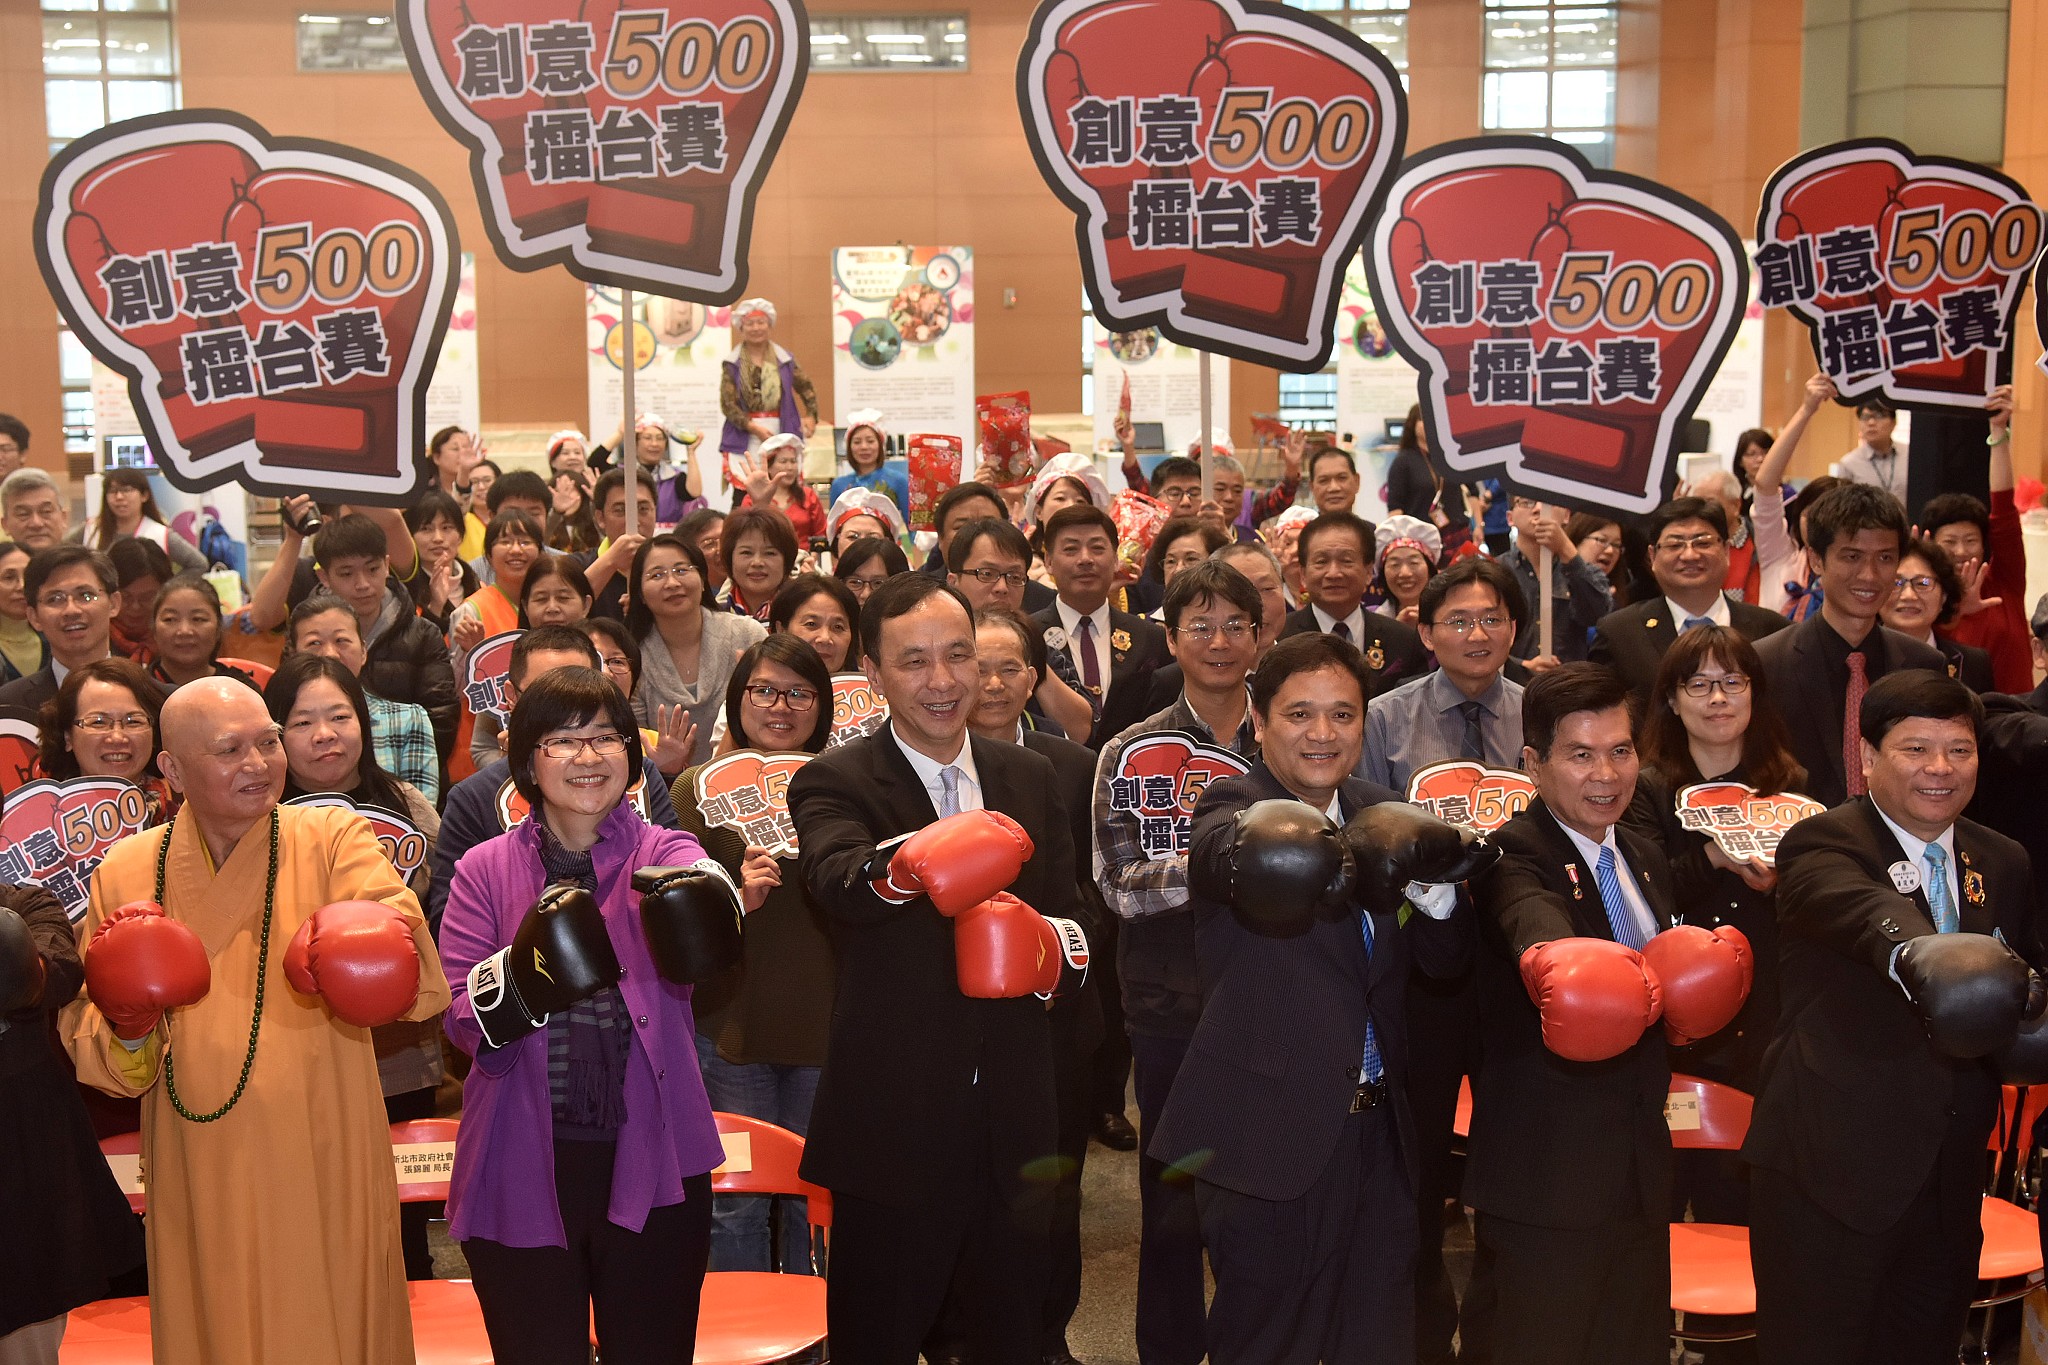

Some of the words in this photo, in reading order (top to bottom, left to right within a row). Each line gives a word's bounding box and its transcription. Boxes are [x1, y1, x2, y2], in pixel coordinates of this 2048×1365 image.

[455, 9, 773, 101] 創意500
[525, 102, 728, 184] 擂台賽
[1070, 88, 1373, 170] 創意500
[1130, 179, 1320, 249] 擂台賽
[1755, 201, 2044, 307] 創意500
[100, 221, 423, 329] 創意500
[1412, 251, 1713, 331] 創意500
[182, 306, 391, 404] 擂台賽
[1471, 337, 1661, 405] 擂台賽
[1820, 288, 2006, 378] 擂台賽
[1110, 771, 1228, 811] 創意5
